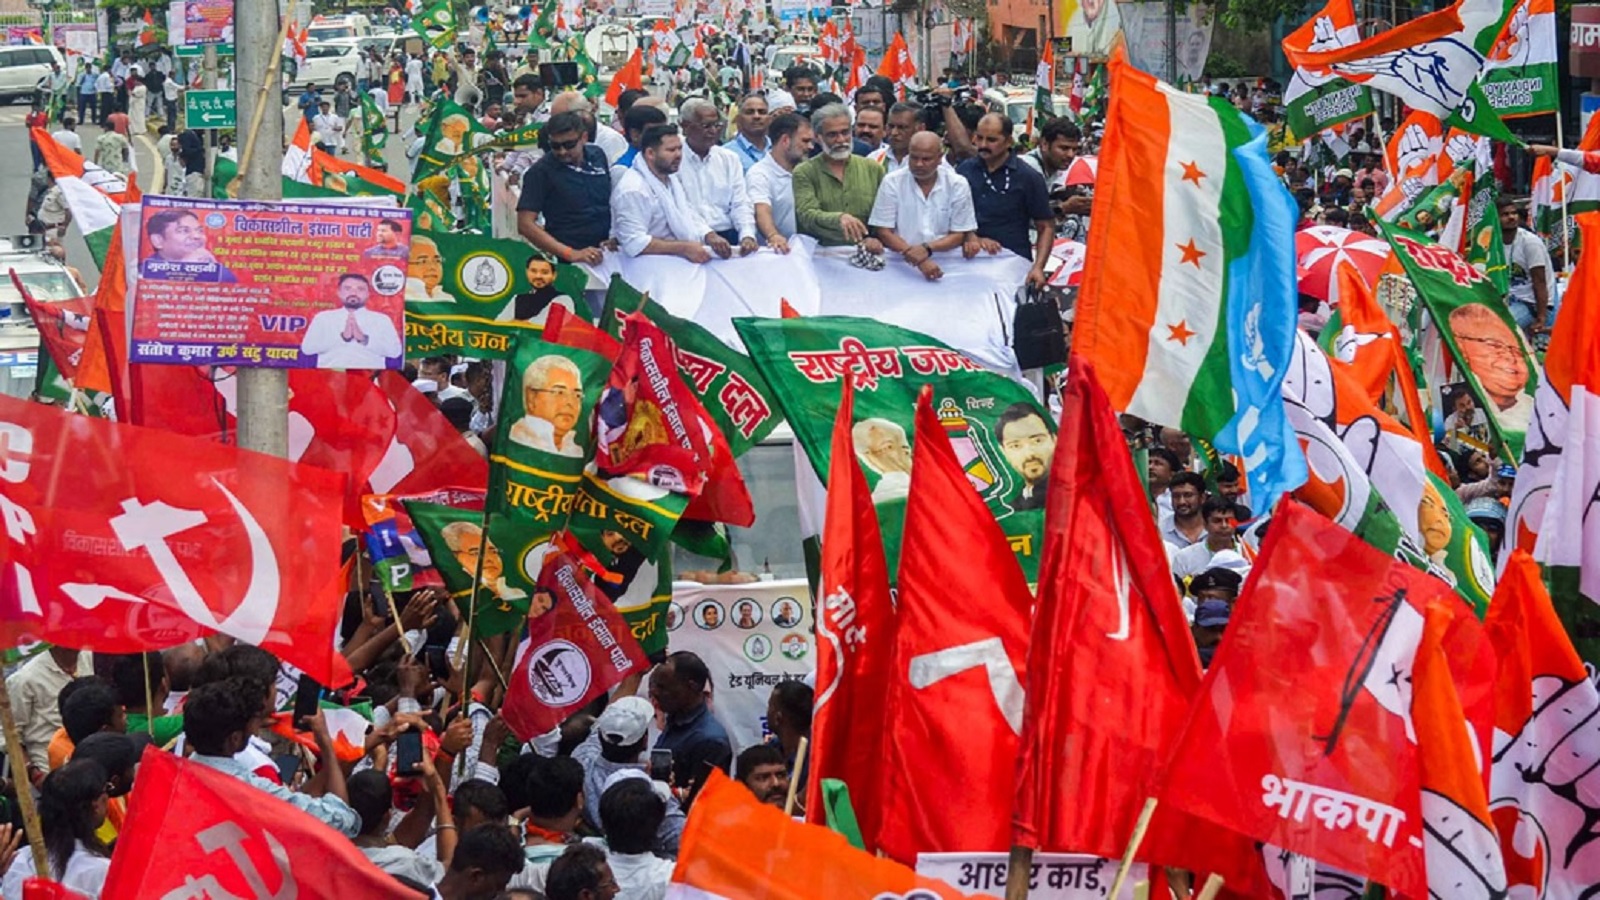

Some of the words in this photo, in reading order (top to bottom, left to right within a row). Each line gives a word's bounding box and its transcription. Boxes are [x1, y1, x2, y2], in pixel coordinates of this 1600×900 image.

[234, 214, 303, 234] विकासशील
[308, 218, 341, 236] इंसान
[147, 261, 181, 273] मुकेश
[258, 313, 307, 333] VIP
[137, 341, 175, 357] संतोष
[177, 344, 214, 361] कुमार
[216, 342, 239, 358] उर्फ
[265, 346, 299, 361] यादव
[467, 330, 510, 352] जन
[787, 337, 903, 392] राष्ट्रीय
[717, 371, 772, 440] दल
[613, 509, 655, 542] दल
[1261, 773, 1407, 849] भाकपा
[958, 862, 1042, 890] आधर
